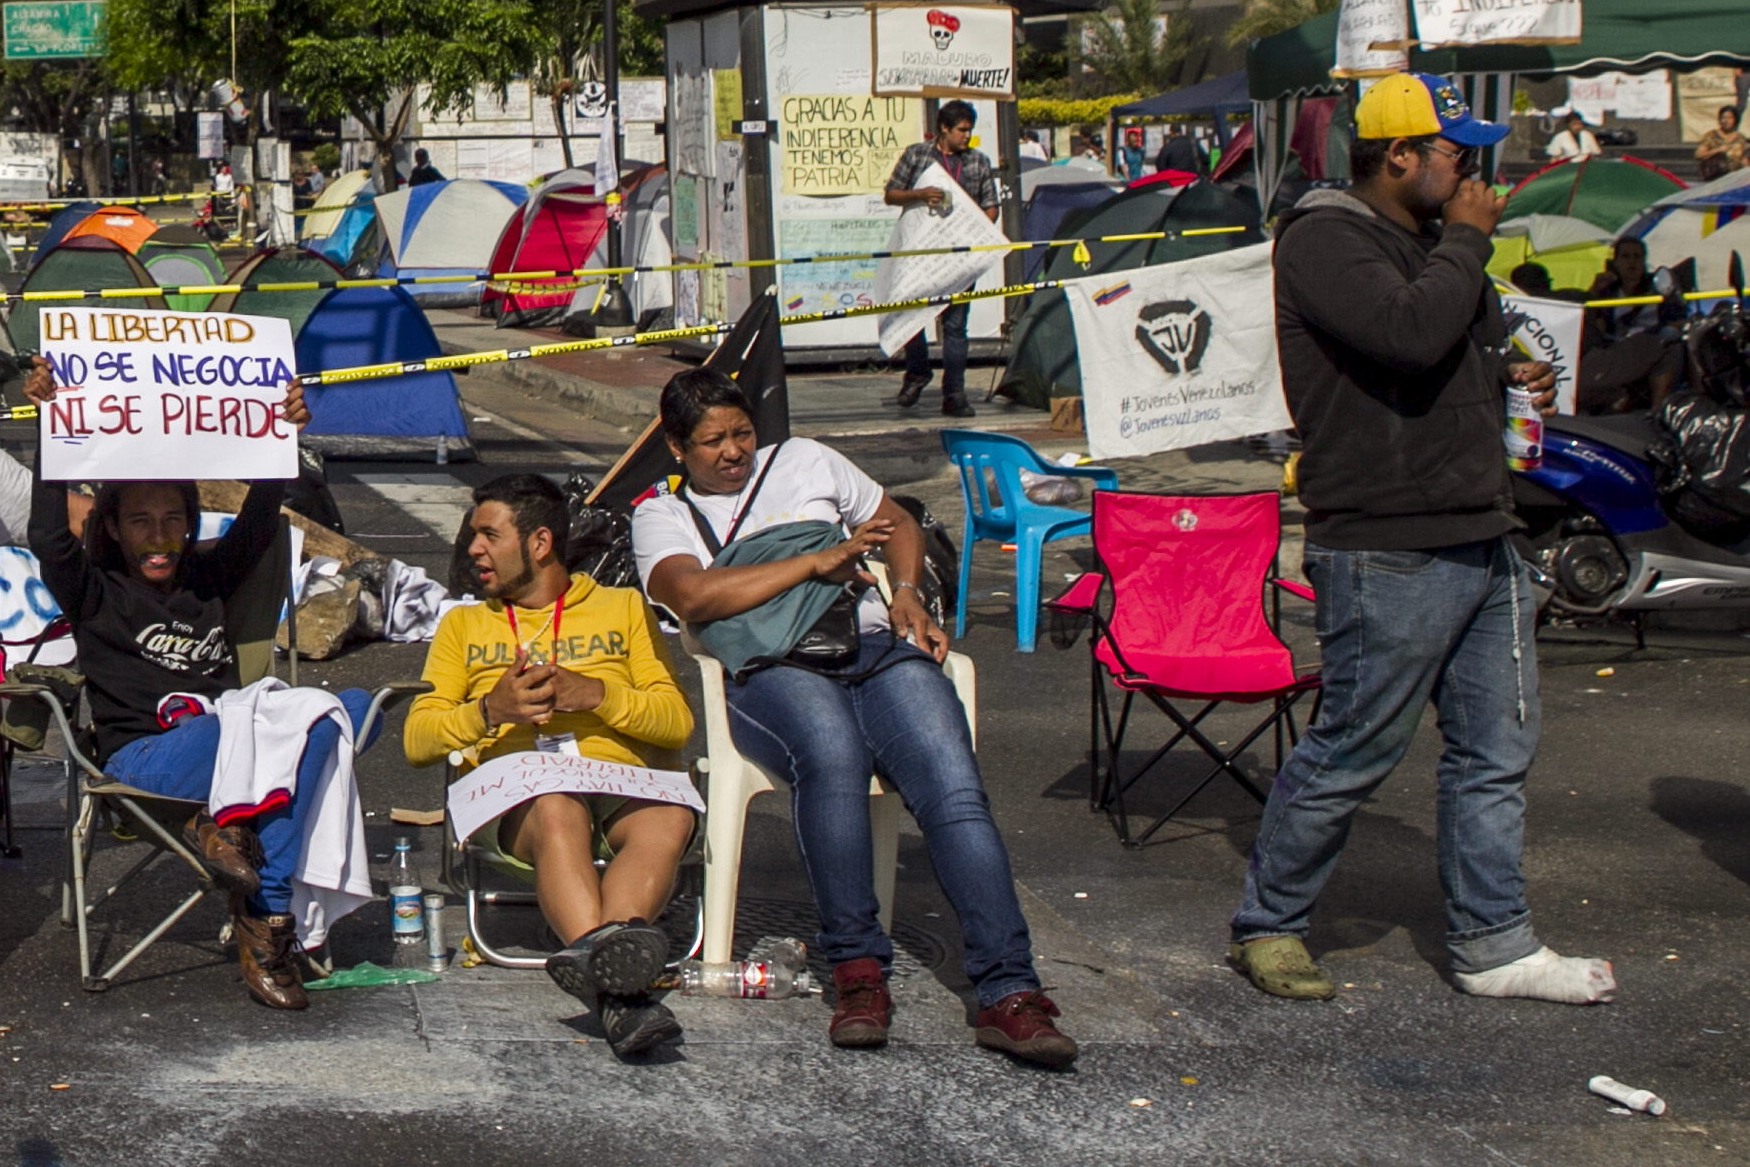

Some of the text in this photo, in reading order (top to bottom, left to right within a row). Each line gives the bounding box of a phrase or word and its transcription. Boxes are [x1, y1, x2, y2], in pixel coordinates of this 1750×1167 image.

[784, 97, 905, 126] GRACIAS A TU
[787, 127, 898, 149] INDIFERENCIA
[788, 149, 864, 167] TENEMOS
[44, 312, 256, 344] LA LIBERTAD
[46, 350, 296, 388] NO SE NEGOCIA
[50, 393, 289, 440] NI SE PIERDE
